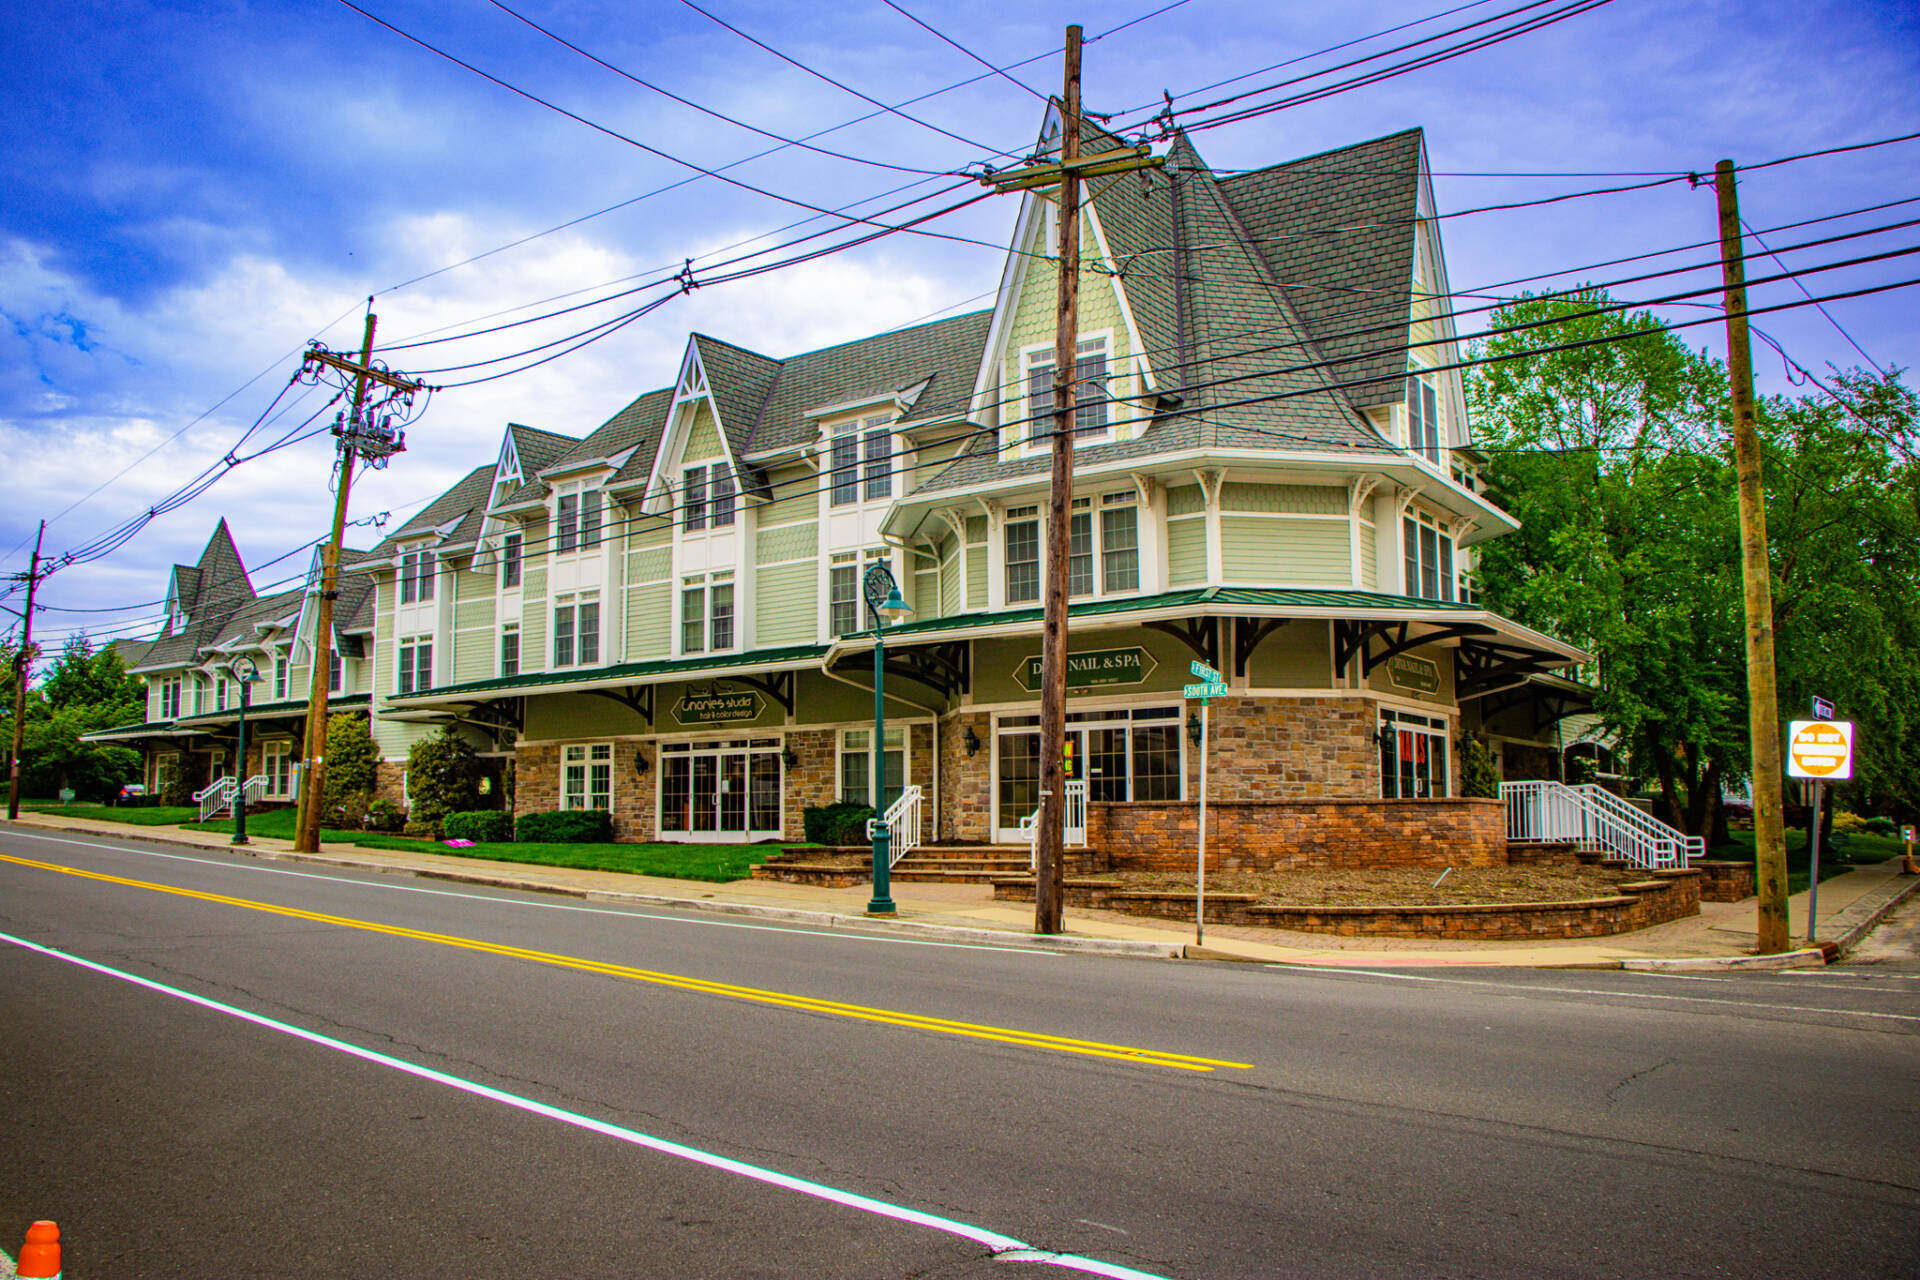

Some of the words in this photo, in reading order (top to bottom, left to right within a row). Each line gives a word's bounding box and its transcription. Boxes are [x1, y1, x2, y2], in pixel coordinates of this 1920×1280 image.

[1068, 657, 1100, 672] NAIL
[1195, 662, 1211, 678] FIRST
[1187, 686, 1209, 697] SOUTH
[1210, 684, 1225, 695] AVE
[1798, 732, 1815, 742] DO
